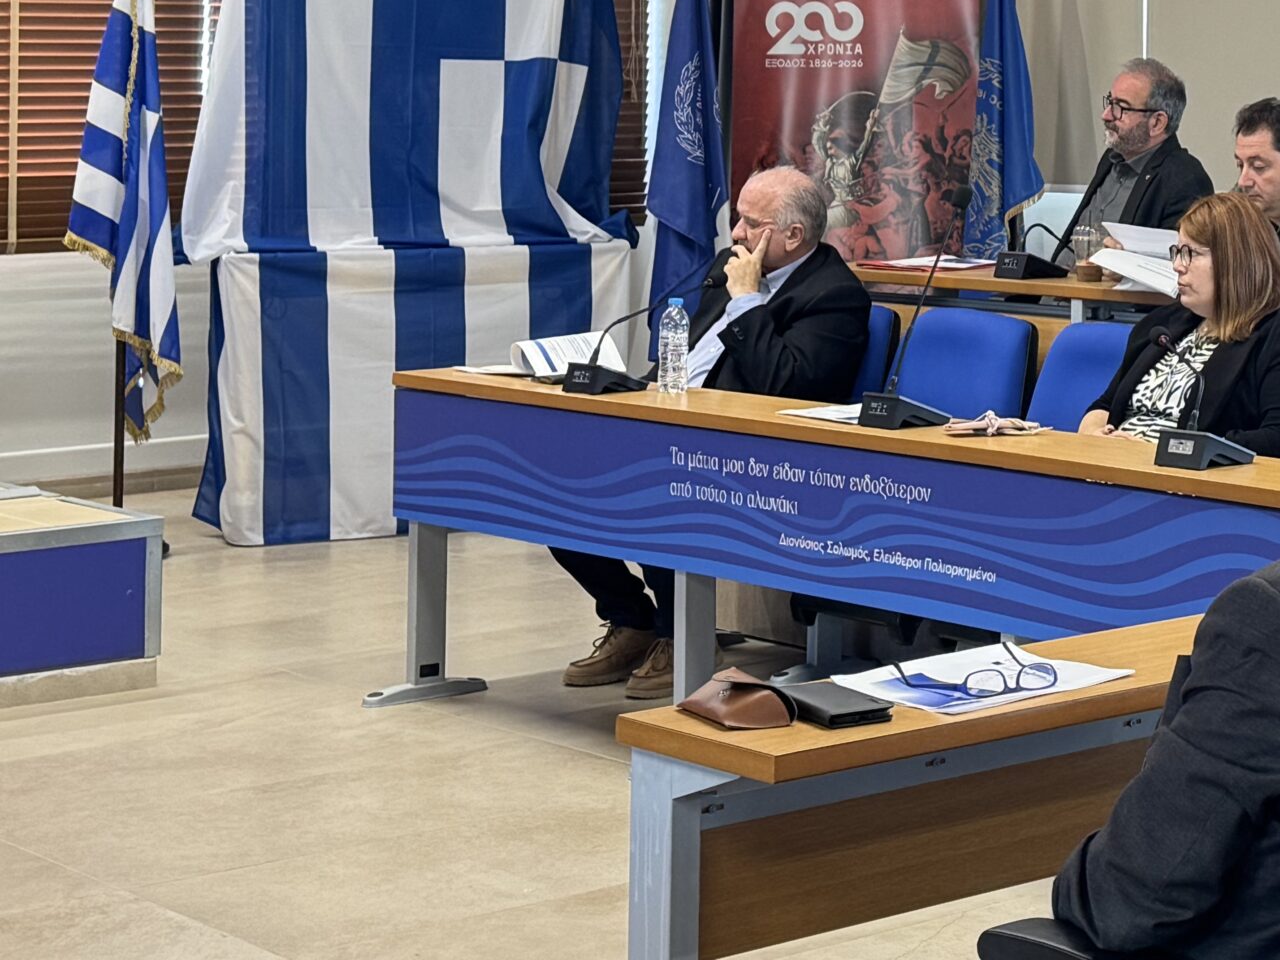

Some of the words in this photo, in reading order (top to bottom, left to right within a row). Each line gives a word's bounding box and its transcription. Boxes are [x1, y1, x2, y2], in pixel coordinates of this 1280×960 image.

[765, 1, 864, 55] 200
[807, 43, 863, 55] ΧΡΟΝΙΑ
[765, 59, 806, 68] ΕΞΟΔΟΣ
[670, 445, 685, 465] Τα
[688, 451, 719, 472] μάτια
[722, 458, 745, 477] μου
[748, 457, 769, 478] δεν
[773, 462, 805, 483] είδαν
[809, 469, 846, 489] τόπον
[850, 473, 932, 504] ενδοξότερον
[670, 480, 692, 498] από
[695, 484, 727, 504] τούτο
[730, 491, 743, 506] το
[747, 491, 799, 515] αλωνάκι
[779, 533, 825, 555] Διονύσιος
[826, 541, 871, 562] Σολωμός,
[873, 548, 922, 570] Ελεύθεροι
[924, 557, 996, 583] Πολιορκημένοι
